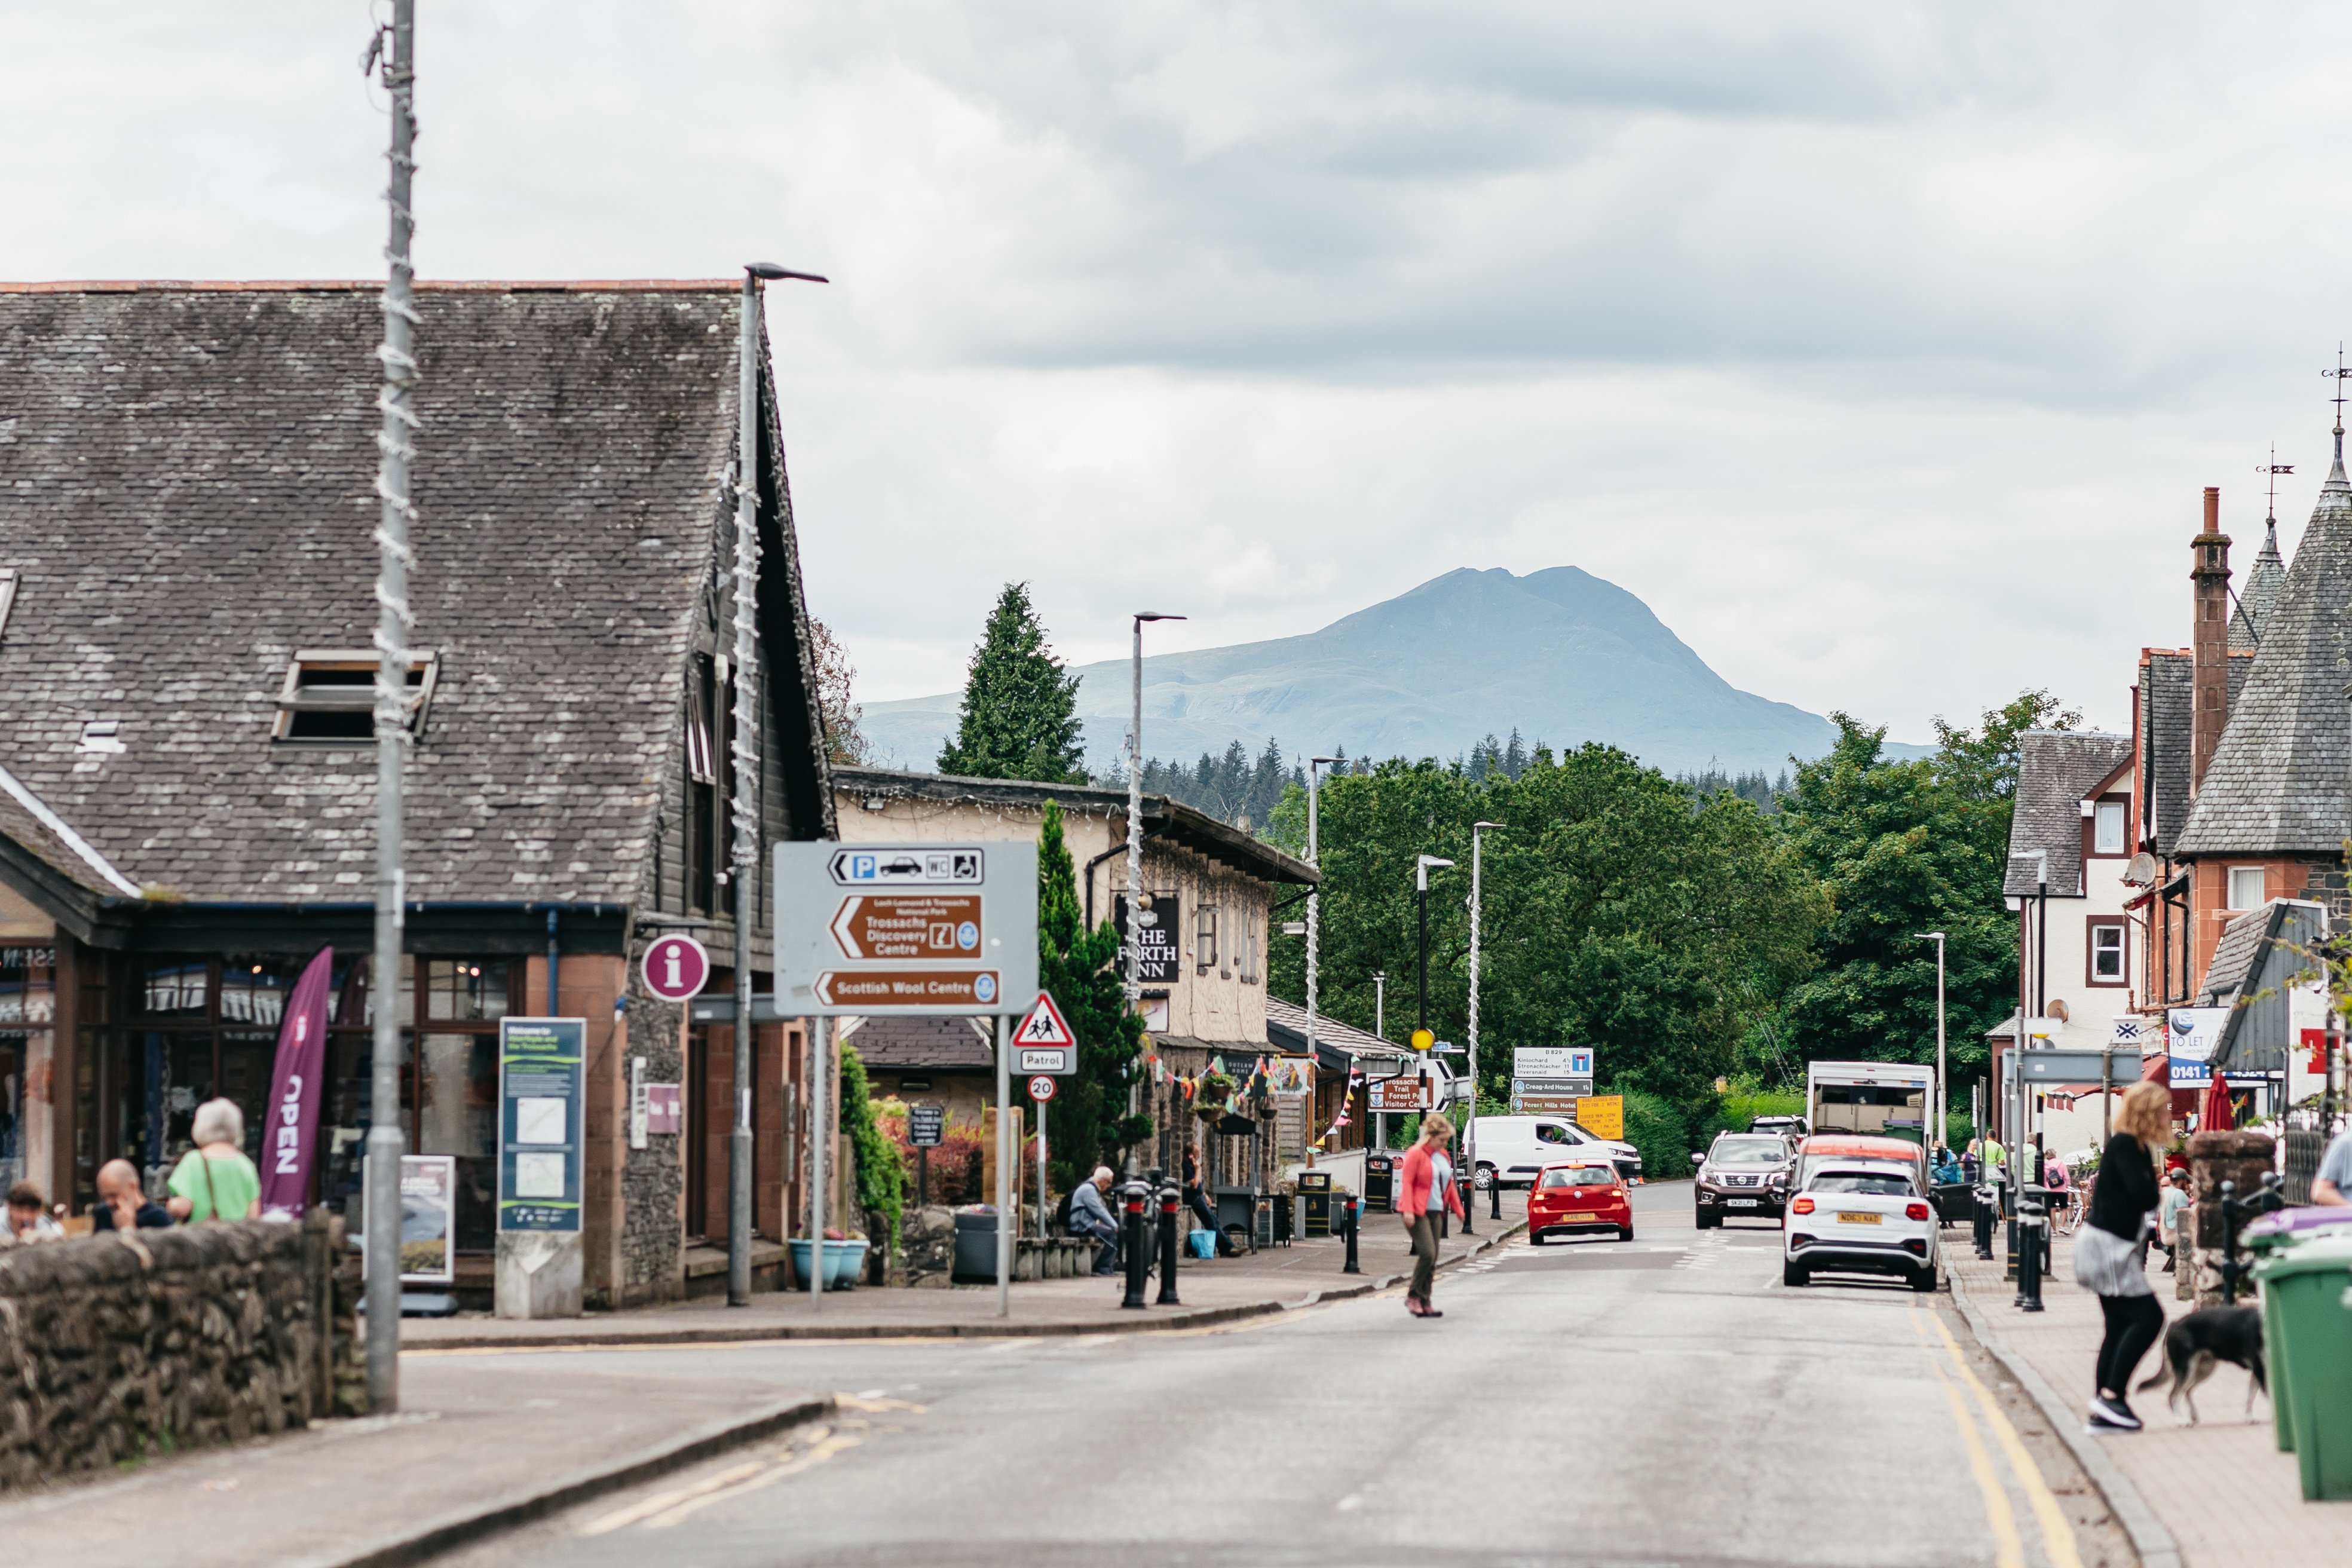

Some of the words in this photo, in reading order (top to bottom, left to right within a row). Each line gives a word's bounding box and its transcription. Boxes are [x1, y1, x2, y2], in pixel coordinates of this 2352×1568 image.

[929, 860, 947, 872] WC
[893, 899, 924, 907] Lomond
[933, 898, 970, 907] Trossachs
[866, 916, 927, 929] Trossachs
[866, 929, 927, 944] Discovery
[1140, 929, 1166, 944] HE
[875, 942, 918, 956] Centre
[1137, 963, 1166, 978] NN
[837, 981, 890, 994] Scottish
[892, 981, 925, 994] Wool
[927, 981, 971, 994] Centre
[2171, 1036, 2185, 1046] TO
[2189, 1036, 2204, 1046] LET
[1027, 1056, 1059, 1064] Patrol
[2171, 1066, 2200, 1079] 0141
[1033, 1082, 1051, 1094] 20
